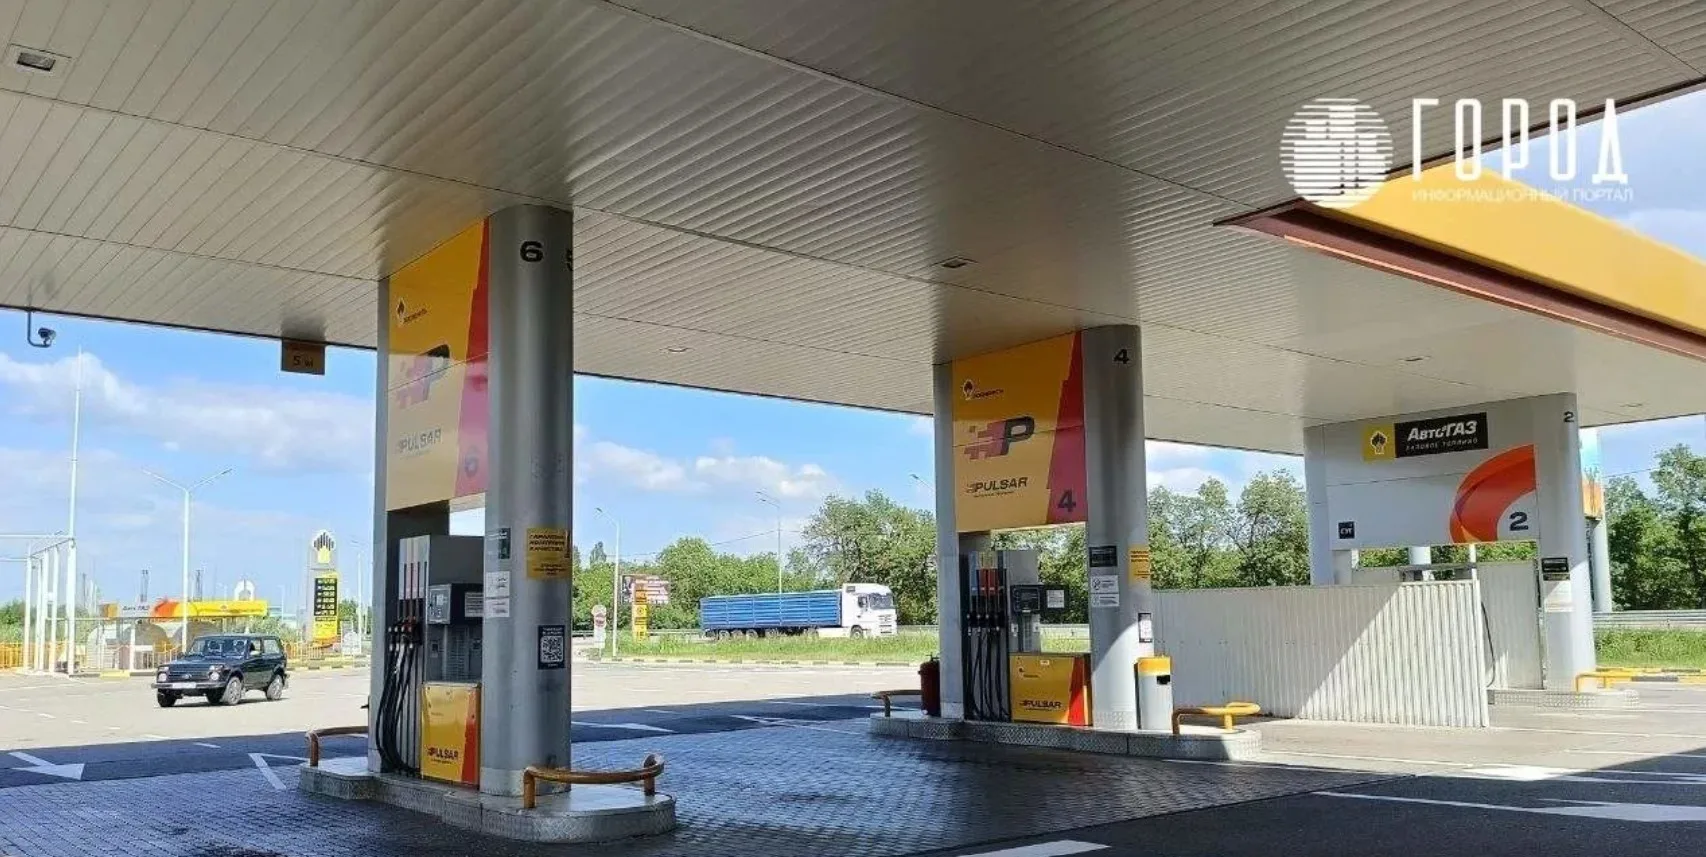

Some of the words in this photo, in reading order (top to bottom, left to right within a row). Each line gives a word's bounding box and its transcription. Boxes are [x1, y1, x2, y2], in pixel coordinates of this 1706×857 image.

[520, 241, 543, 262] 6
[1113, 348, 1130, 364] 4
[1563, 411, 1575, 423] 2
[399, 428, 442, 453] PULSAR
[465, 445, 478, 478] 6
[972, 477, 1028, 492] PULSAR
[1057, 489, 1077, 512] 4
[1509, 512, 1529, 531] 2
